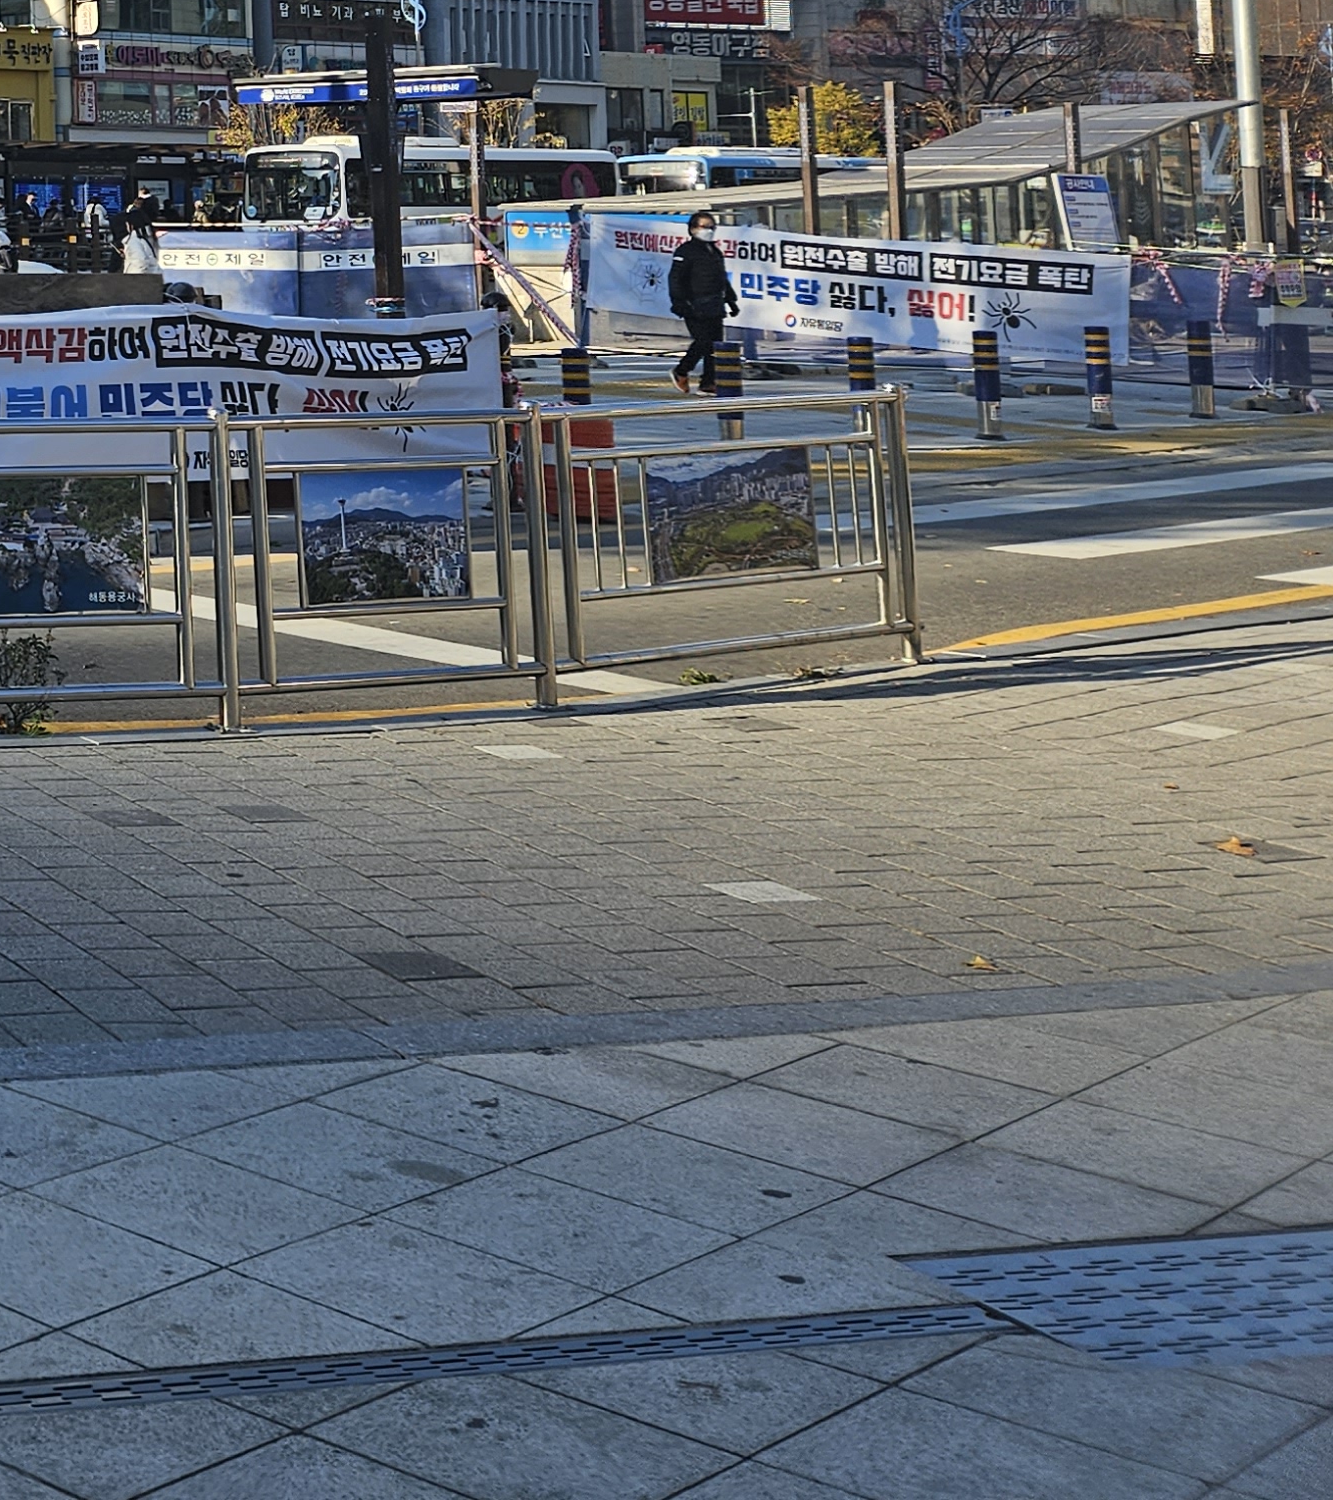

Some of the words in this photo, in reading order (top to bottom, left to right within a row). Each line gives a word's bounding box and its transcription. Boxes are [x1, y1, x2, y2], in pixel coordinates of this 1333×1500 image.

[279, 3, 290, 18] 탑
[162, 253, 201, 266] 안전
[224, 253, 267, 267] 제일
[322, 253, 366, 268] 안전
[781, 242, 869, 274] 원전수출
[874, 250, 921, 278] 방해
[931, 254, 1031, 287] 전기요금
[1037, 266, 1093, 293] 폭탄
[739, 271, 821, 306] 민주당
[829, 280, 896, 318] 싫다,
[907, 290, 976, 323] 싫어!
[800, 317, 843, 332] 자유통일당
[157, 324, 261, 363] 원전수출
[265, 333, 320, 370] 방해
[325, 338, 422, 372] 전기요금
[424, 336, 469, 365] 폭탄
